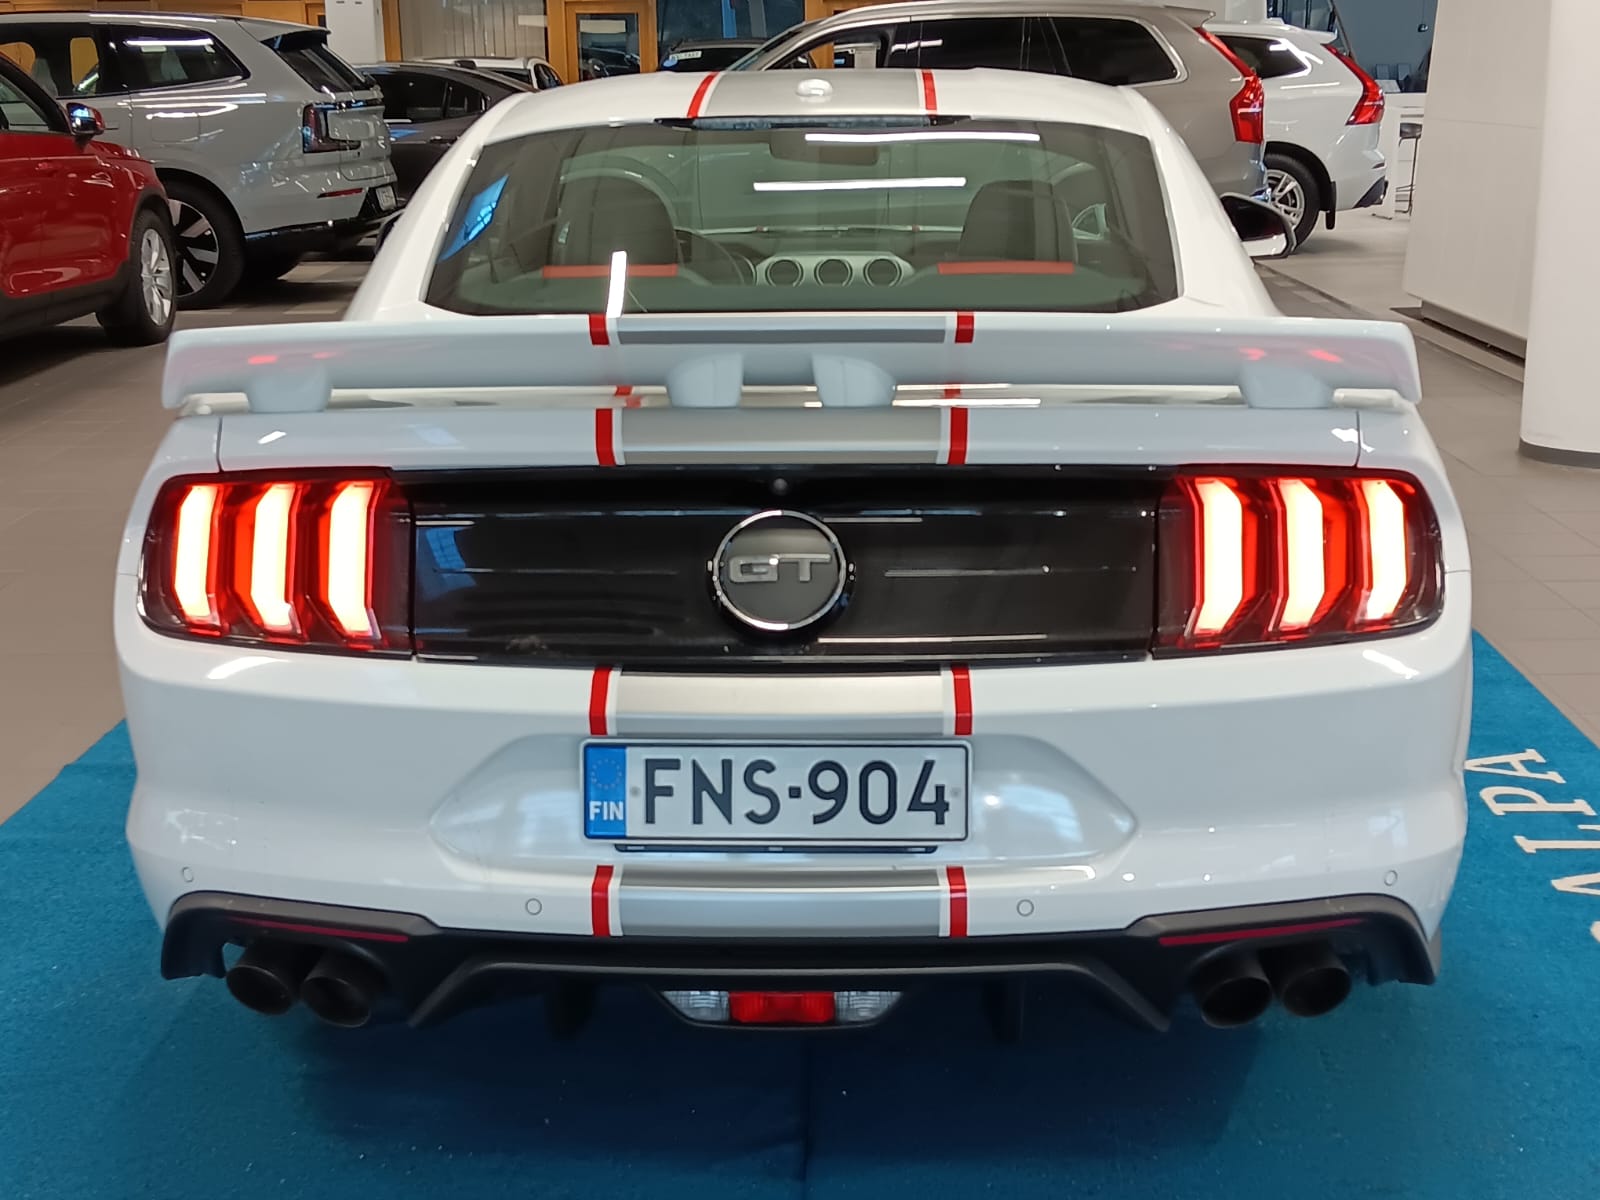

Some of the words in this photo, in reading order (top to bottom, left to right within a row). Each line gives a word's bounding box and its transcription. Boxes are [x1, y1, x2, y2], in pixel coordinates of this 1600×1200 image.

[729, 553, 831, 582] GT
[645, 758, 950, 825] FNS-904
[588, 800, 624, 821] FIN
